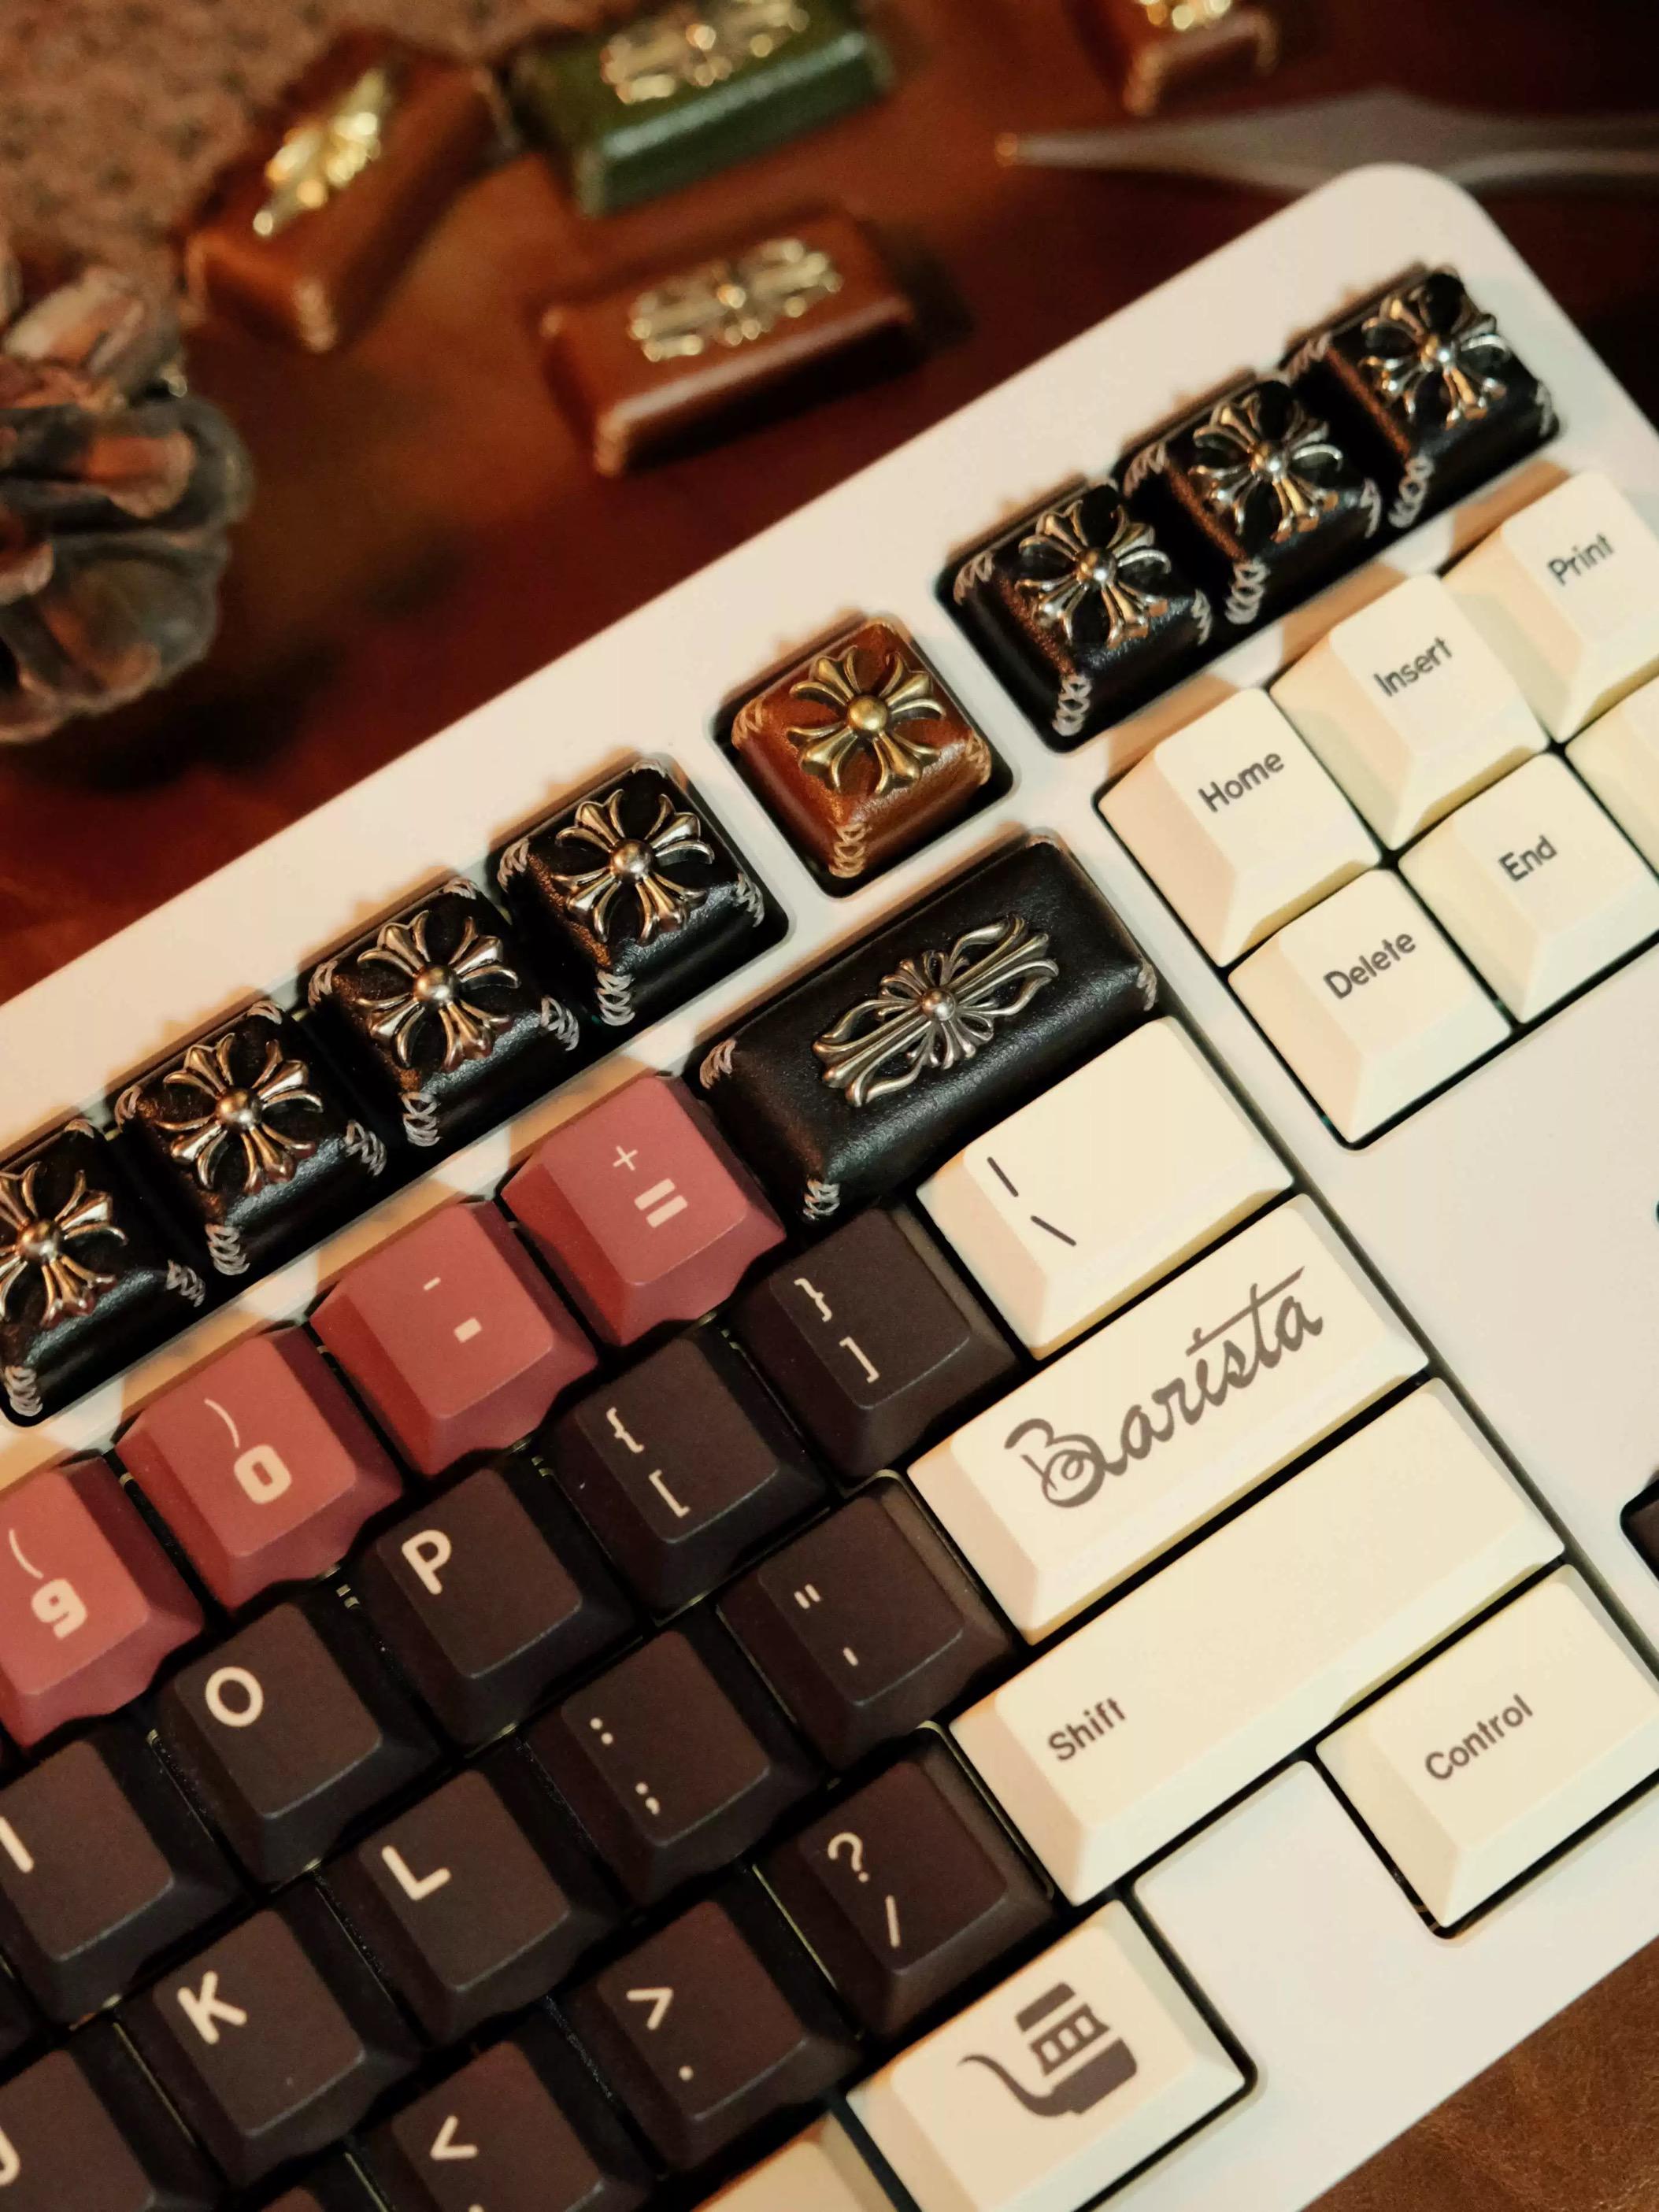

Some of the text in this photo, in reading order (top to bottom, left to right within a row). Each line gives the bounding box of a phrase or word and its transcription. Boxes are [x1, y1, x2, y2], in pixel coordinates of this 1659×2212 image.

[1547, 535, 1613, 585] Print
[1373, 638, 1452, 697] Insert
[1198, 753, 1284, 812] Home
[1498, 835, 1557, 882] End
[1323, 934, 1416, 1000] Delete
[635, 1178, 688, 1227] =
[1003, 1265, 1324, 1508] Barista
[234, 1444, 292, 1504] 0
[402, 1530, 451, 1595] P
[31, 1578, 87, 1639] 9
[205, 1666, 264, 1727] O
[1048, 1698, 1125, 1761] Shift
[1425, 1694, 1533, 1781] Control
[382, 1846, 450, 1900] L
[828, 1833, 868, 1882] ?
[177, 1972, 246, 2044] K
